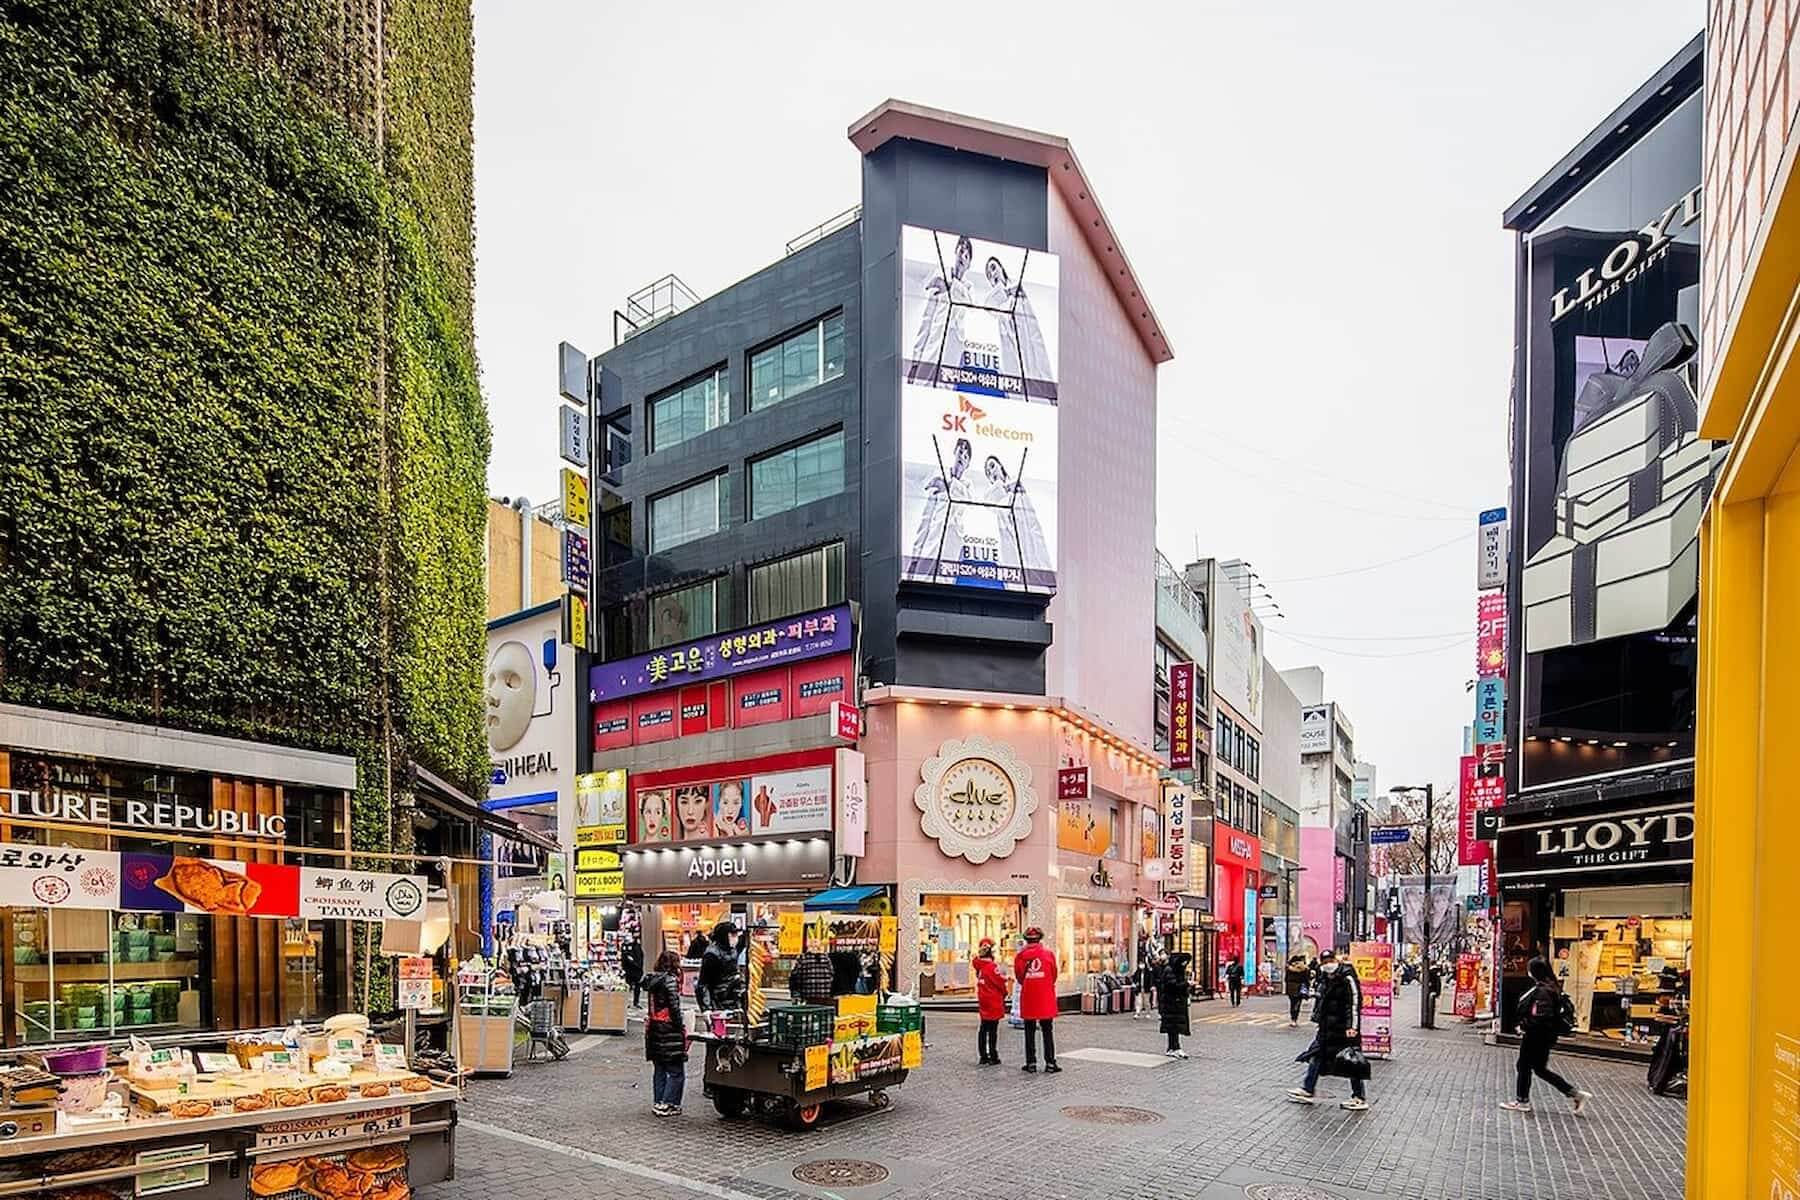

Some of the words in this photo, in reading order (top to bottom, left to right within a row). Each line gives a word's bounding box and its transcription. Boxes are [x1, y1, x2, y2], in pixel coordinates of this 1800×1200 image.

[1585, 280, 1620, 311] THE
[1625, 244, 1670, 283] GIFT
[963, 350, 1000, 370] BLUE
[942, 414, 967, 433] SK
[975, 423, 1033, 443] telecom
[963, 545, 999, 561] BLUE
[1480, 618, 1503, 637] 2F
[0, 789, 110, 823] TURE
[127, 800, 286, 837] REPUBLIC
[1536, 812, 1695, 855] LLOYD
[1573, 852, 1605, 865] THE
[1609, 849, 1648, 862] GIFT
[304, 897, 361, 905] CROISSANT
[318, 906, 384, 917] TAIYAKI
